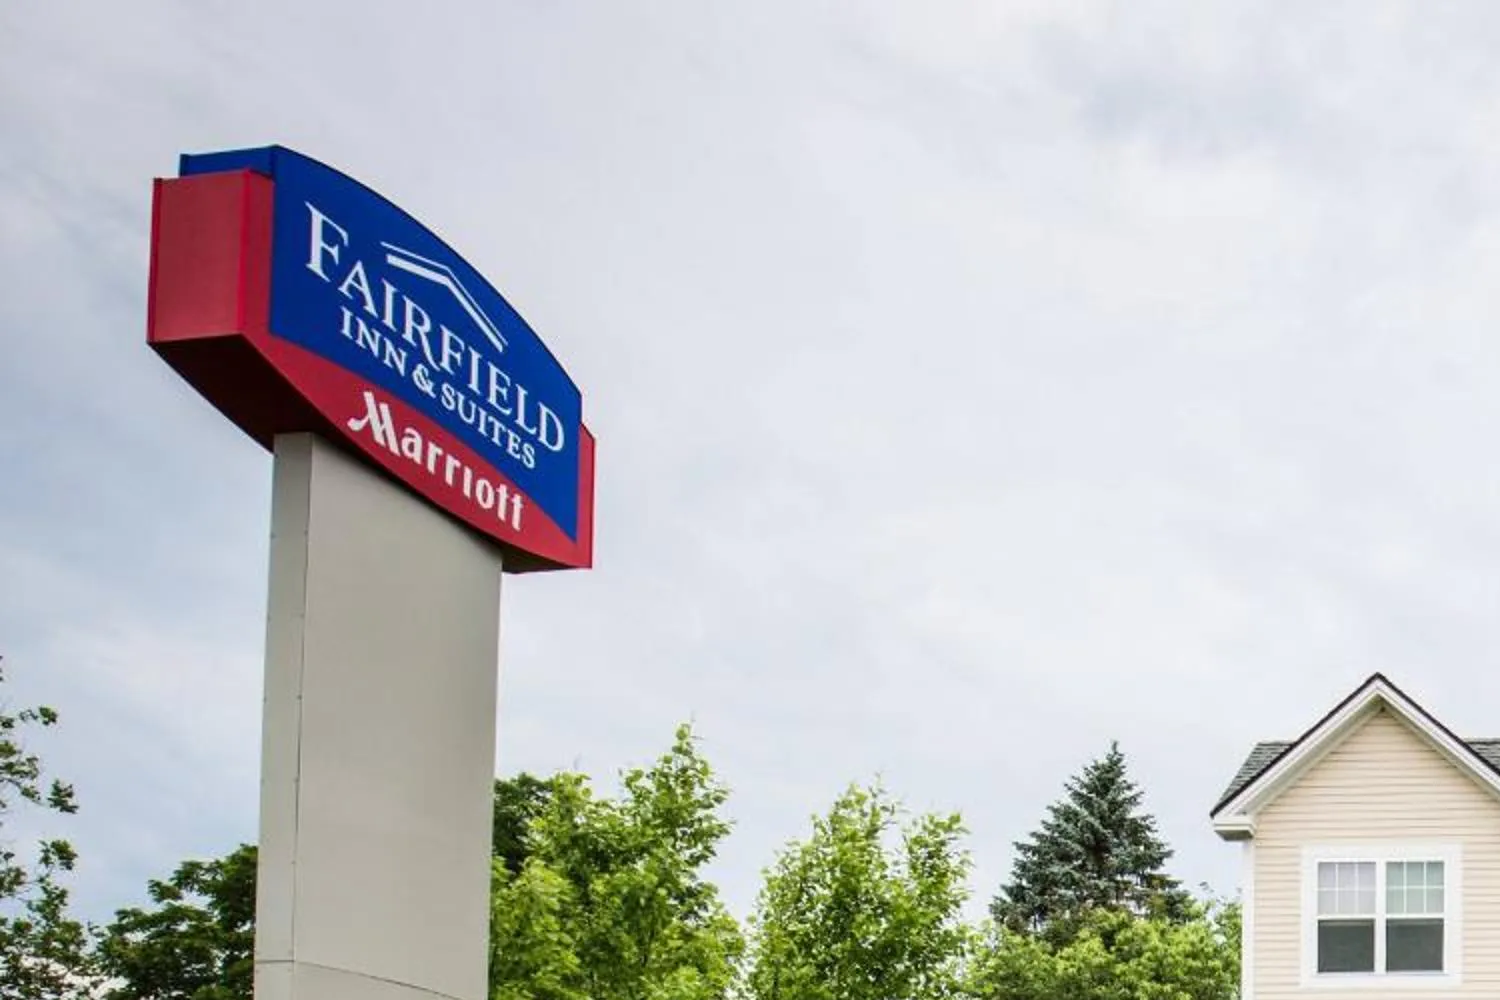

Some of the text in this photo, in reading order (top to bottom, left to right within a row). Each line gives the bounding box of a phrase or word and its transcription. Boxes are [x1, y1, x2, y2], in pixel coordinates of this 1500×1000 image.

[304, 201, 565, 454] FAIRFIELD
[341, 306, 536, 470] INN & SUITES
[347, 391, 524, 531] Marriott
